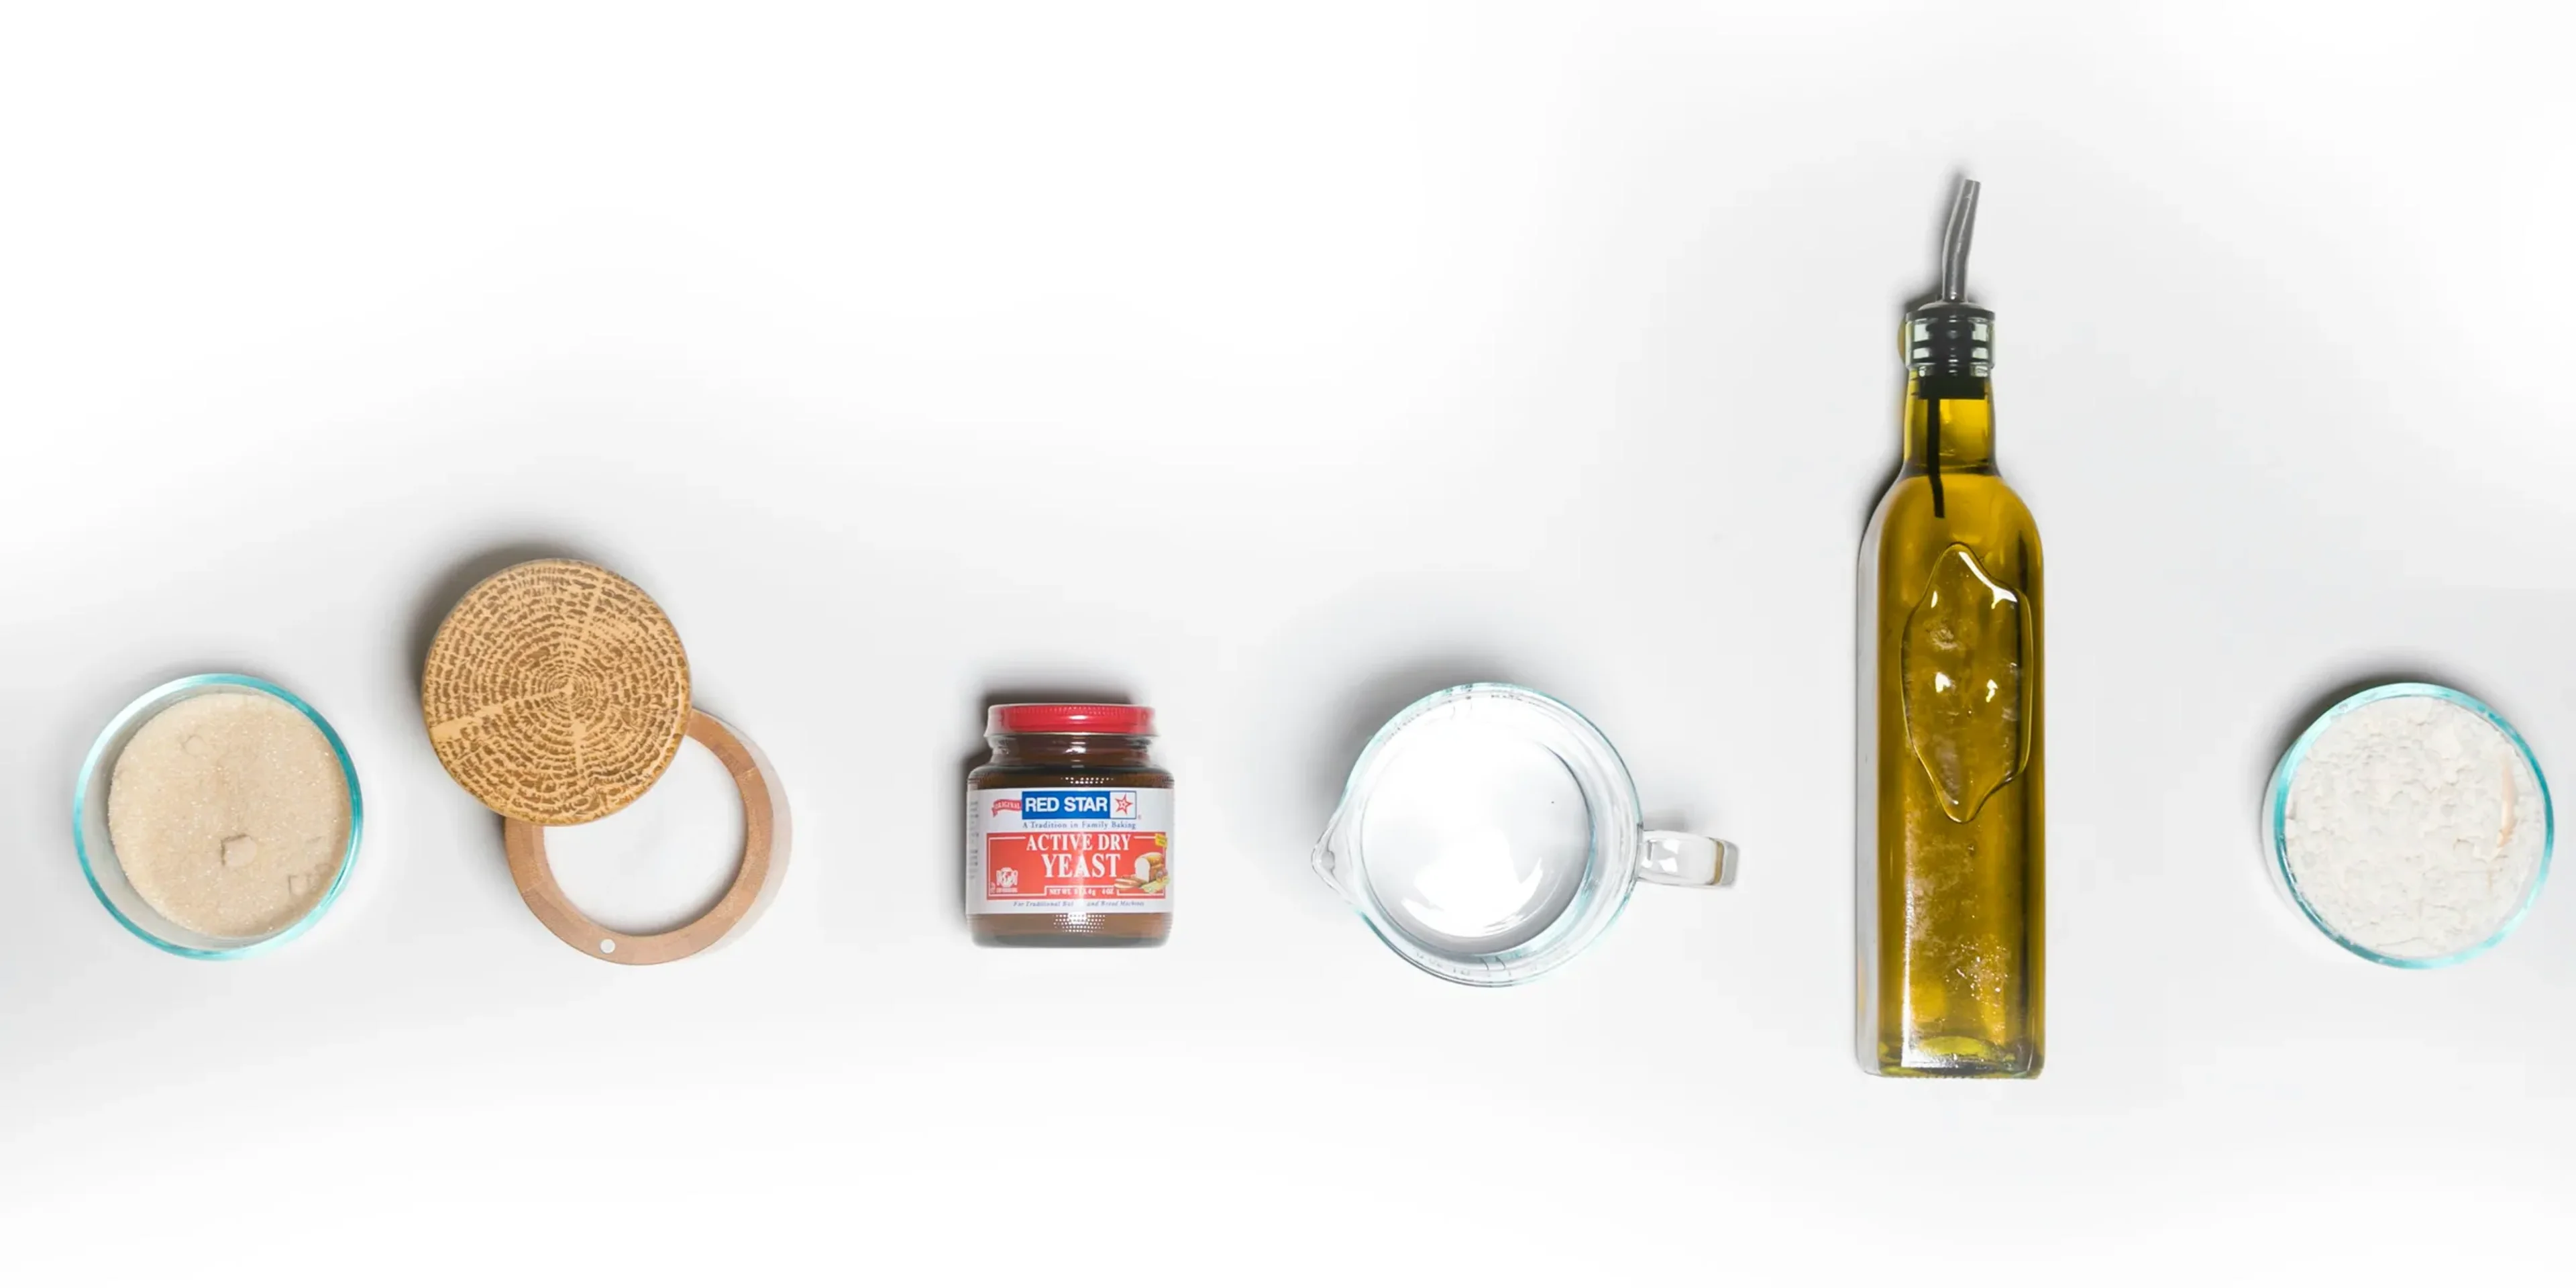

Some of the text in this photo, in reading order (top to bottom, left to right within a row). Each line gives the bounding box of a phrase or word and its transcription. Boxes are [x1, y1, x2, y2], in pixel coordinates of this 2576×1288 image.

[1024, 796, 1108, 812] RED STAR
[1082, 821, 1108, 830] Family
[1112, 821, 1136, 830] Baking
[1026, 834, 1131, 851] ACTIVE DRY
[1041, 853, 1121, 878] YEAST
